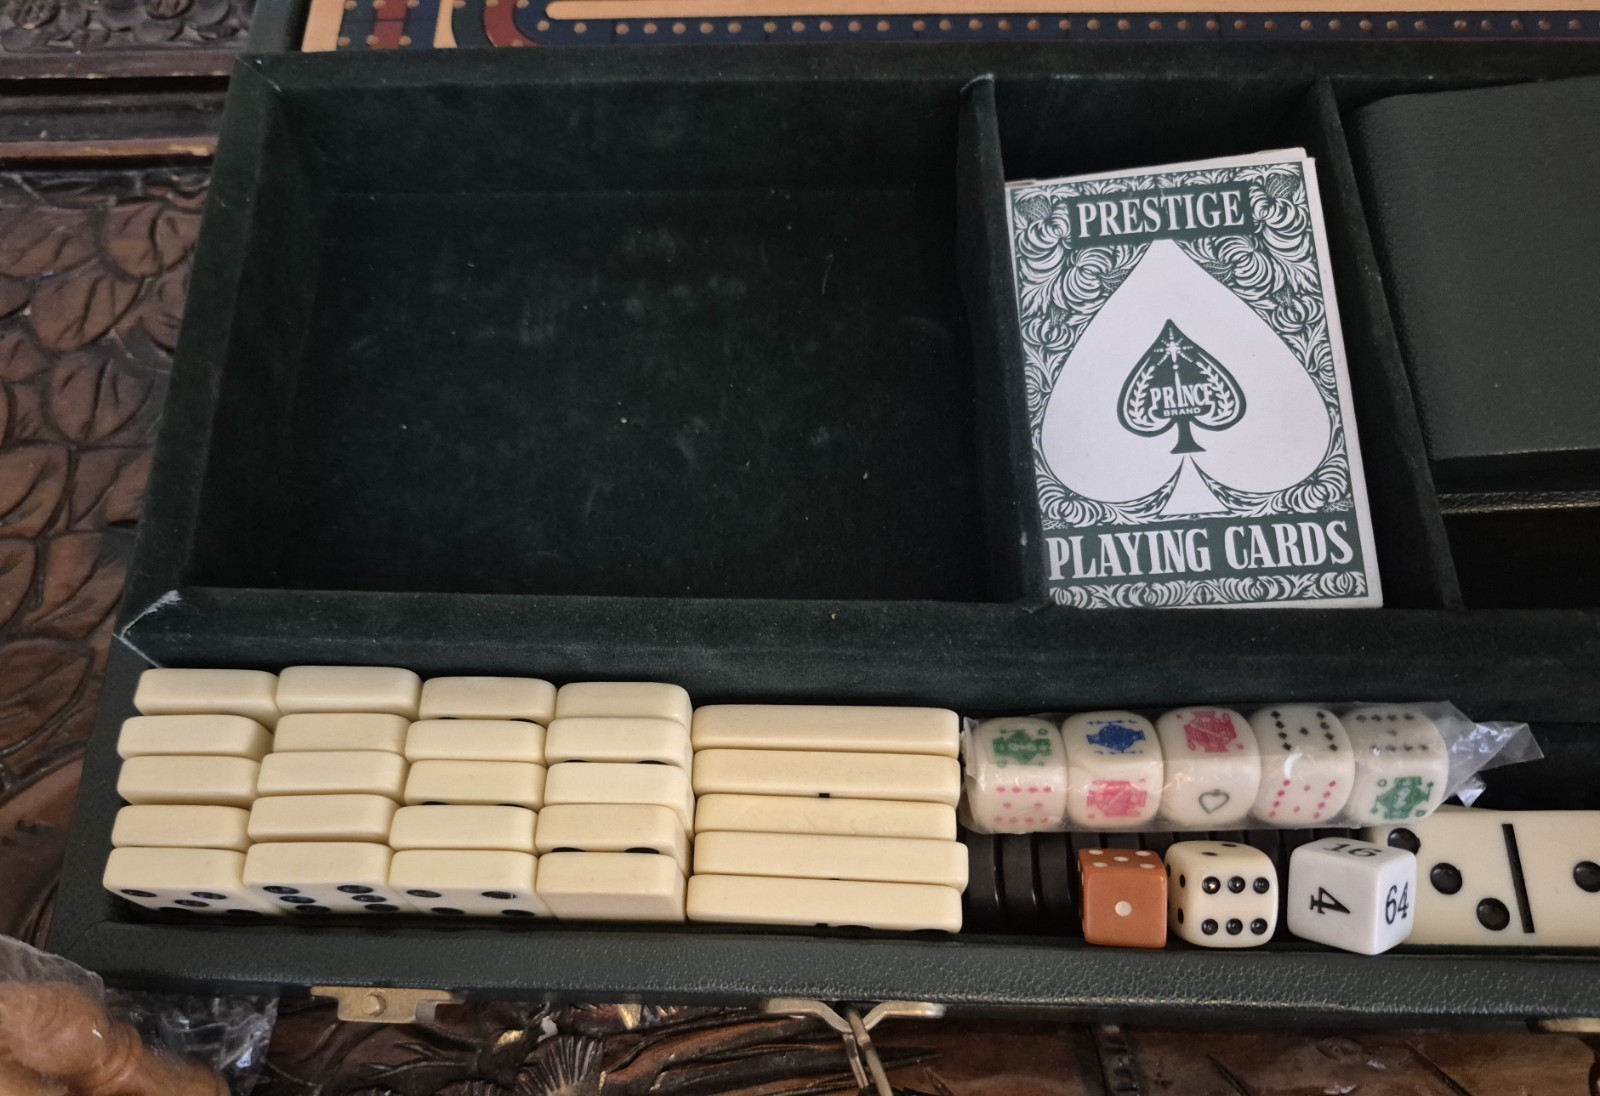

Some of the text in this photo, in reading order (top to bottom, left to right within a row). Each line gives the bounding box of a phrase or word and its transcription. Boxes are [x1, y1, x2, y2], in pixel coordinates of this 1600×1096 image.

[1076, 189, 1245, 239] PRESTIGE
[1150, 374, 1214, 410] PRINCE
[1163, 406, 1202, 417] BRAND
[1045, 520, 1354, 581] PLAYING CARDS
[1309, 886, 1351, 915] 4
[1384, 881, 1410, 925] 64
